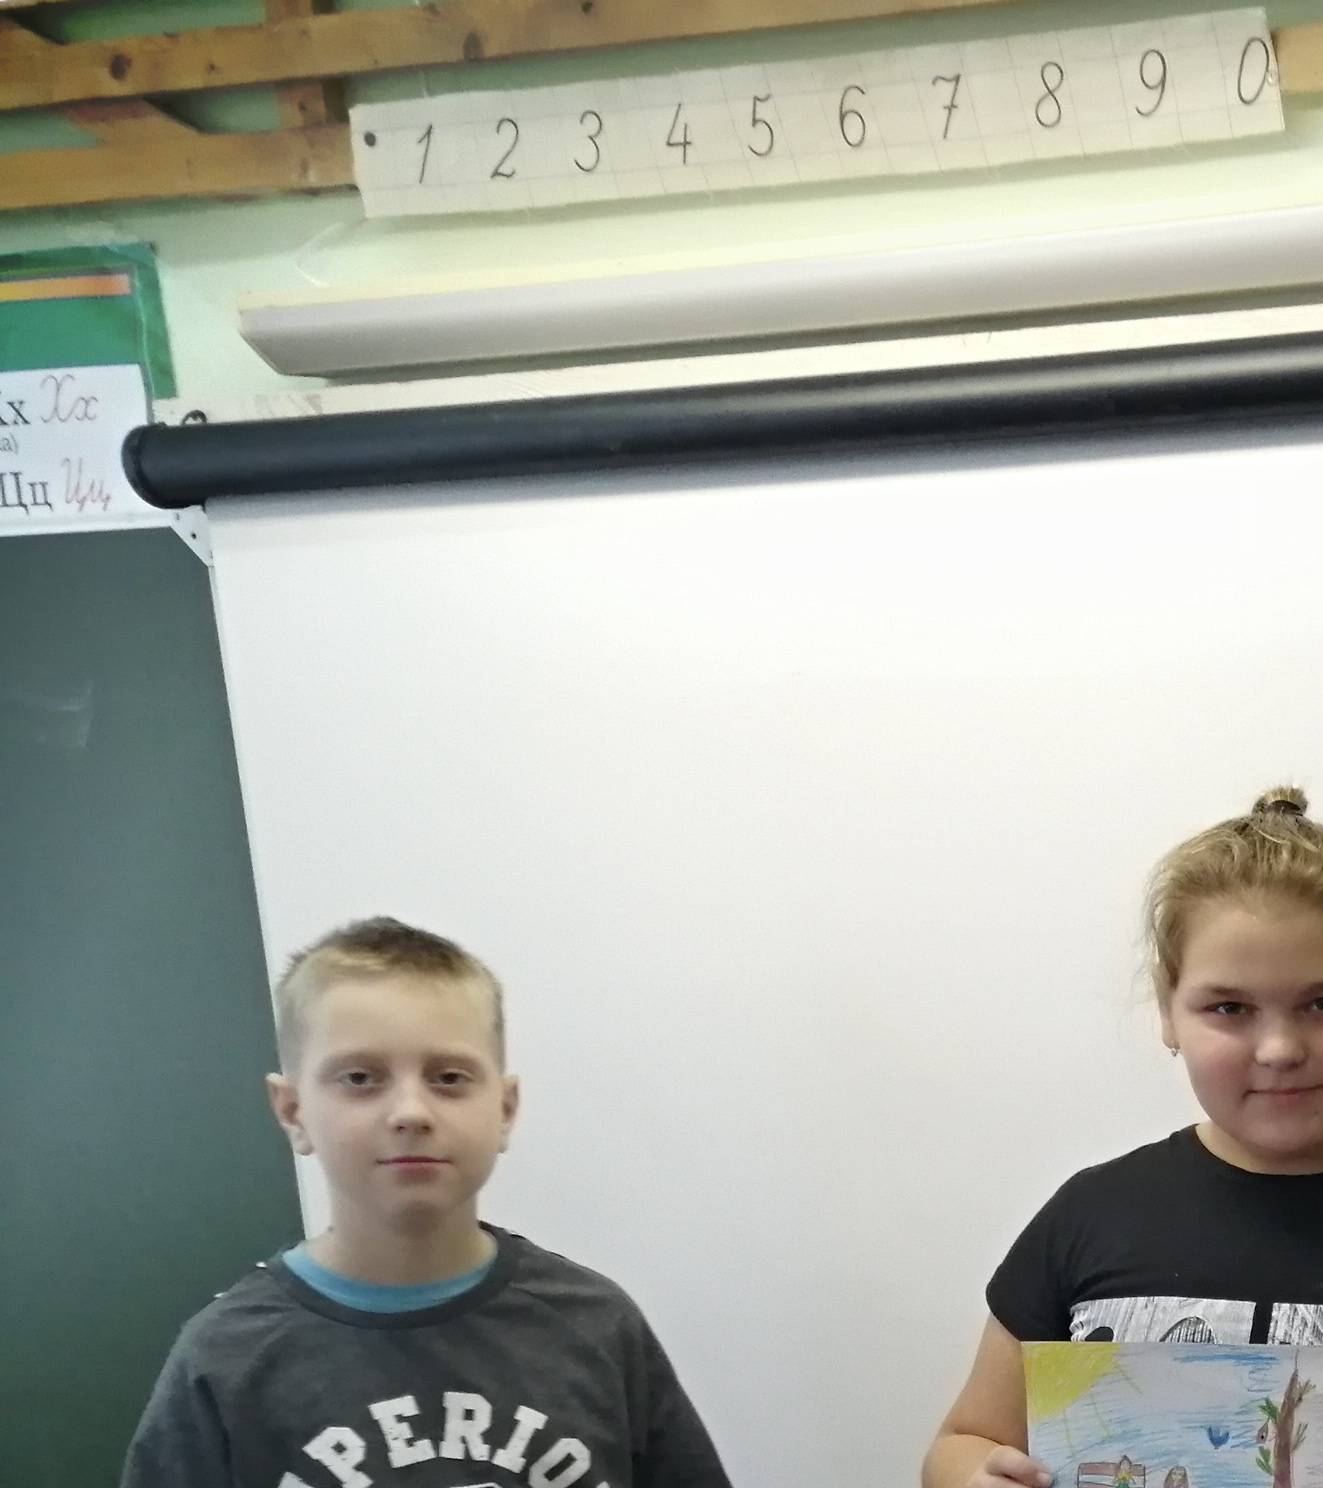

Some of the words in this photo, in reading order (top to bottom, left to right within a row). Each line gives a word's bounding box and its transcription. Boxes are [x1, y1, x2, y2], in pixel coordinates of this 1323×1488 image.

[417, 124, 433, 185] 1
[490, 117, 519, 180] 2
[574, 110, 603, 174] 3
[666, 102, 693, 166] 4
[748, 93, 776, 159] 5
[838, 86, 867, 149] 6
[931, 73, 961, 140] 7
[1034, 61, 1064, 128] 8
[1135, 49, 1167, 117] 9
[1236, 37, 1270, 106] 0
